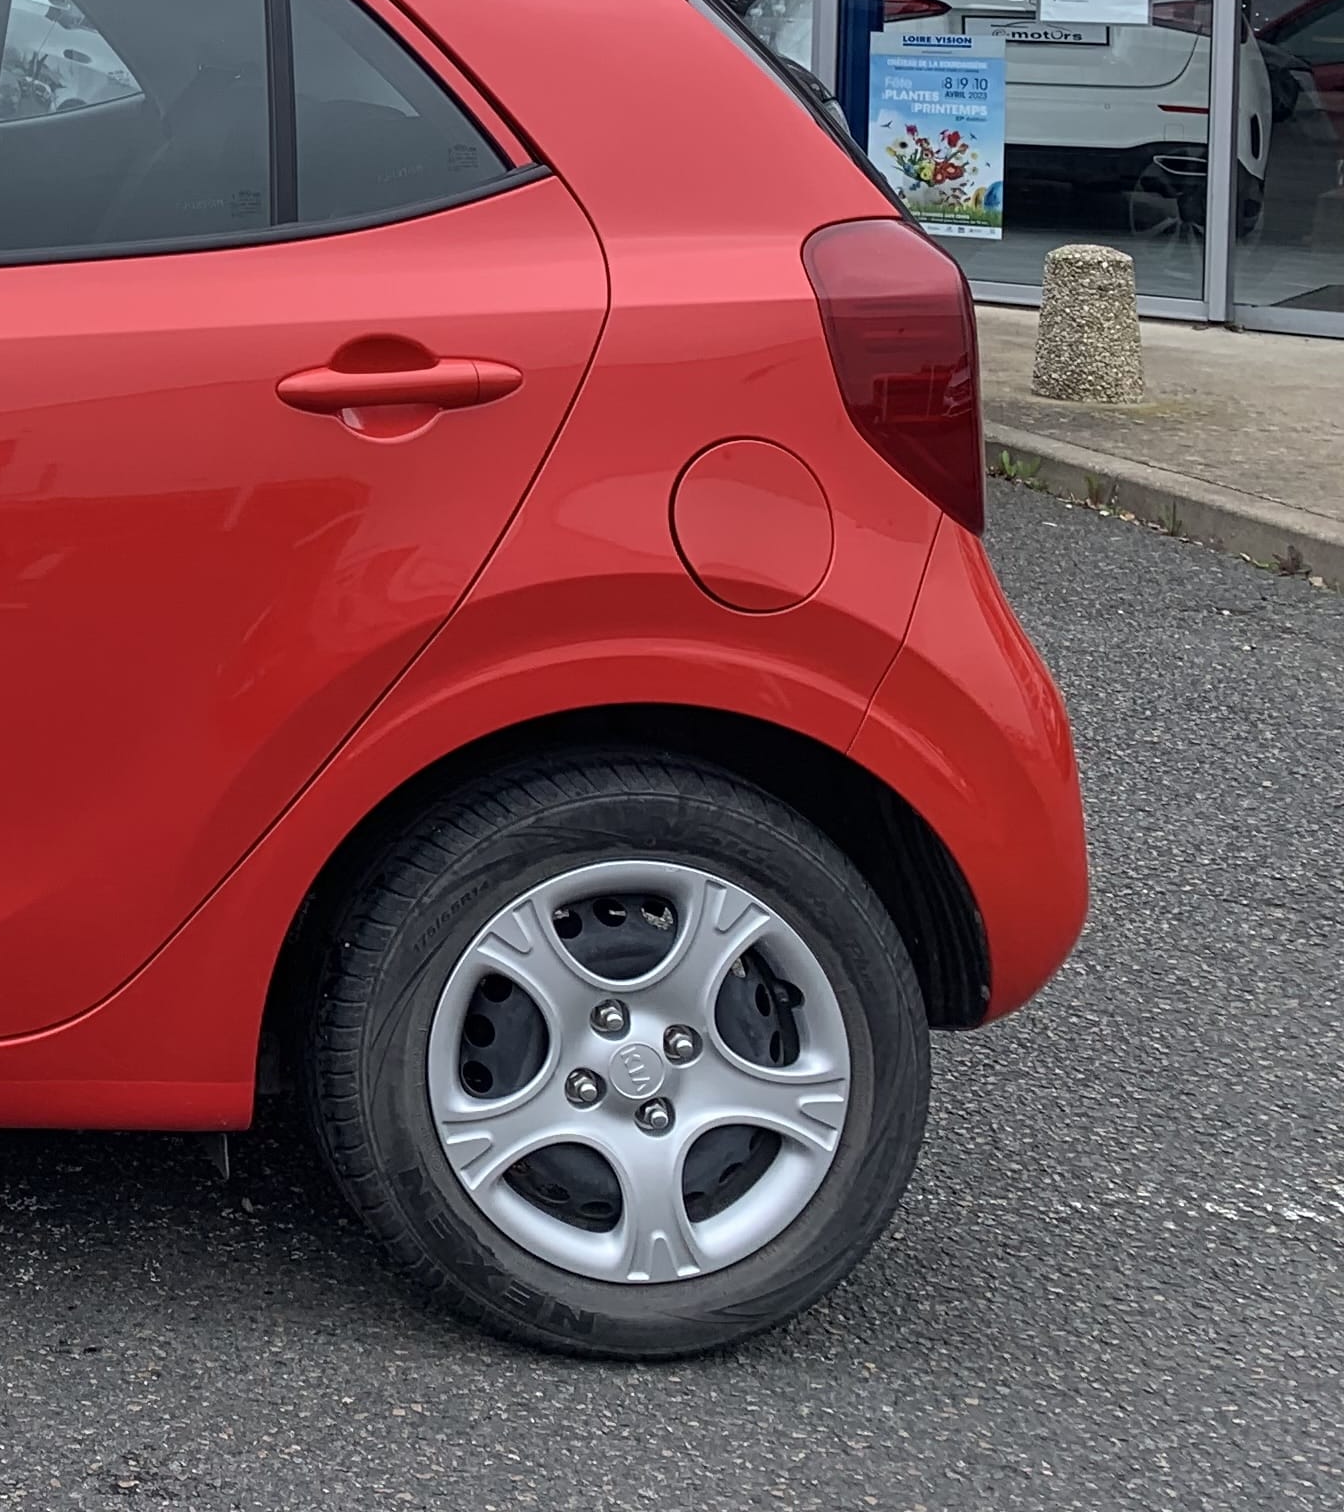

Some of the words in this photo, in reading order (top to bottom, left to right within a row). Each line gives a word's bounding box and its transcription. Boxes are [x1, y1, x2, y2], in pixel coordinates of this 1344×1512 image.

[902, 35, 931, 43] LOIRE
[935, 36, 972, 44] VISION
[944, 77, 953, 89] 8
[960, 78, 969, 89] 9
[974, 78, 988, 90] 10
[885, 89, 940, 102] PLANTES
[944, 90, 966, 99] AVRIL
[914, 102, 988, 116] PRINTEMPS
